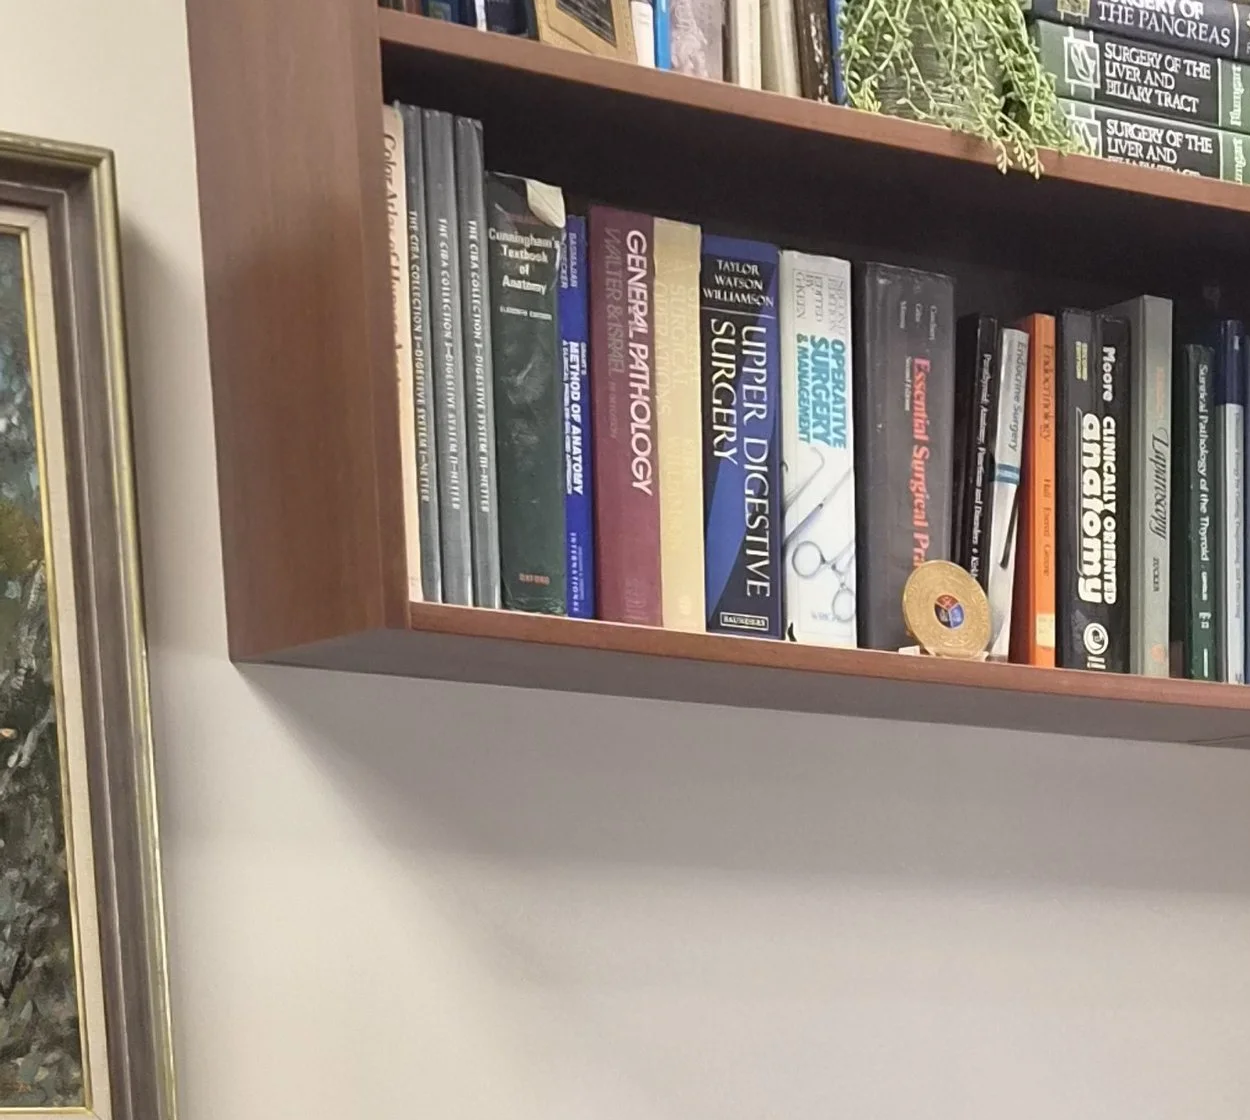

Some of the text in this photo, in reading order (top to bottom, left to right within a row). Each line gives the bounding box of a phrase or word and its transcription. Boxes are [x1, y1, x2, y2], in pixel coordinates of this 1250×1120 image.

[1097, 2, 1231, 48] THE PANCREAS
[1180, 0, 1203, 20] OF
[1104, 42, 1211, 80] SURGERY OF THE
[1105, 62, 1175, 90] LIVER AND
[1105, 79, 1199, 113] BILIARY TRACT
[1106, 119, 1213, 154] SURGERY OF THE
[1107, 137, 1177, 165] LIVER AND
[468, 220, 478, 240] THE
[469, 244, 479, 269] CIBA
[501, 275, 548, 296] Anatomy
[519, 263, 530, 275] of
[603, 227, 623, 300] WALTER
[714, 274, 763, 291] WATSON
[716, 259, 761, 275] TAYLOR
[470, 272, 482, 340] COLLECTION
[703, 288, 774, 308] WILLIAMSON
[607, 321, 625, 377] ISRAEL
[626, 230, 653, 497] GENERAL PATHOLOGY
[669, 282, 688, 389] SURGICAL
[711, 318, 738, 465] SURGERY
[796, 333, 811, 443] & MANAGEMENT
[810, 335, 831, 446] SURGERY
[831, 339, 847, 449] OPERATIVE
[913, 357, 930, 441] Essential
[1009, 341, 1027, 452] Endocrine Surgery
[1040, 343, 1054, 443] Endocrinology
[1102, 345, 1116, 402] Moore
[1197, 363, 1209, 413] Surgical
[569, 341, 583, 495] METHOD OF ANATOMY
[1197, 415, 1209, 477] Pathology
[741, 325, 770, 597] UPPER DIGESTIVE
[910, 444, 930, 526] Surgical
[1149, 427, 1169, 540] Laparoscopy
[1199, 478, 1209, 493] of
[1078, 413, 1104, 604] anatomy
[1102, 416, 1117, 605] CLINICALLY ORIENTED
[1199, 494, 1209, 513] the
[1199, 515, 1210, 561] Thyroid
[570, 533, 579, 613] INTERNATIONAL
